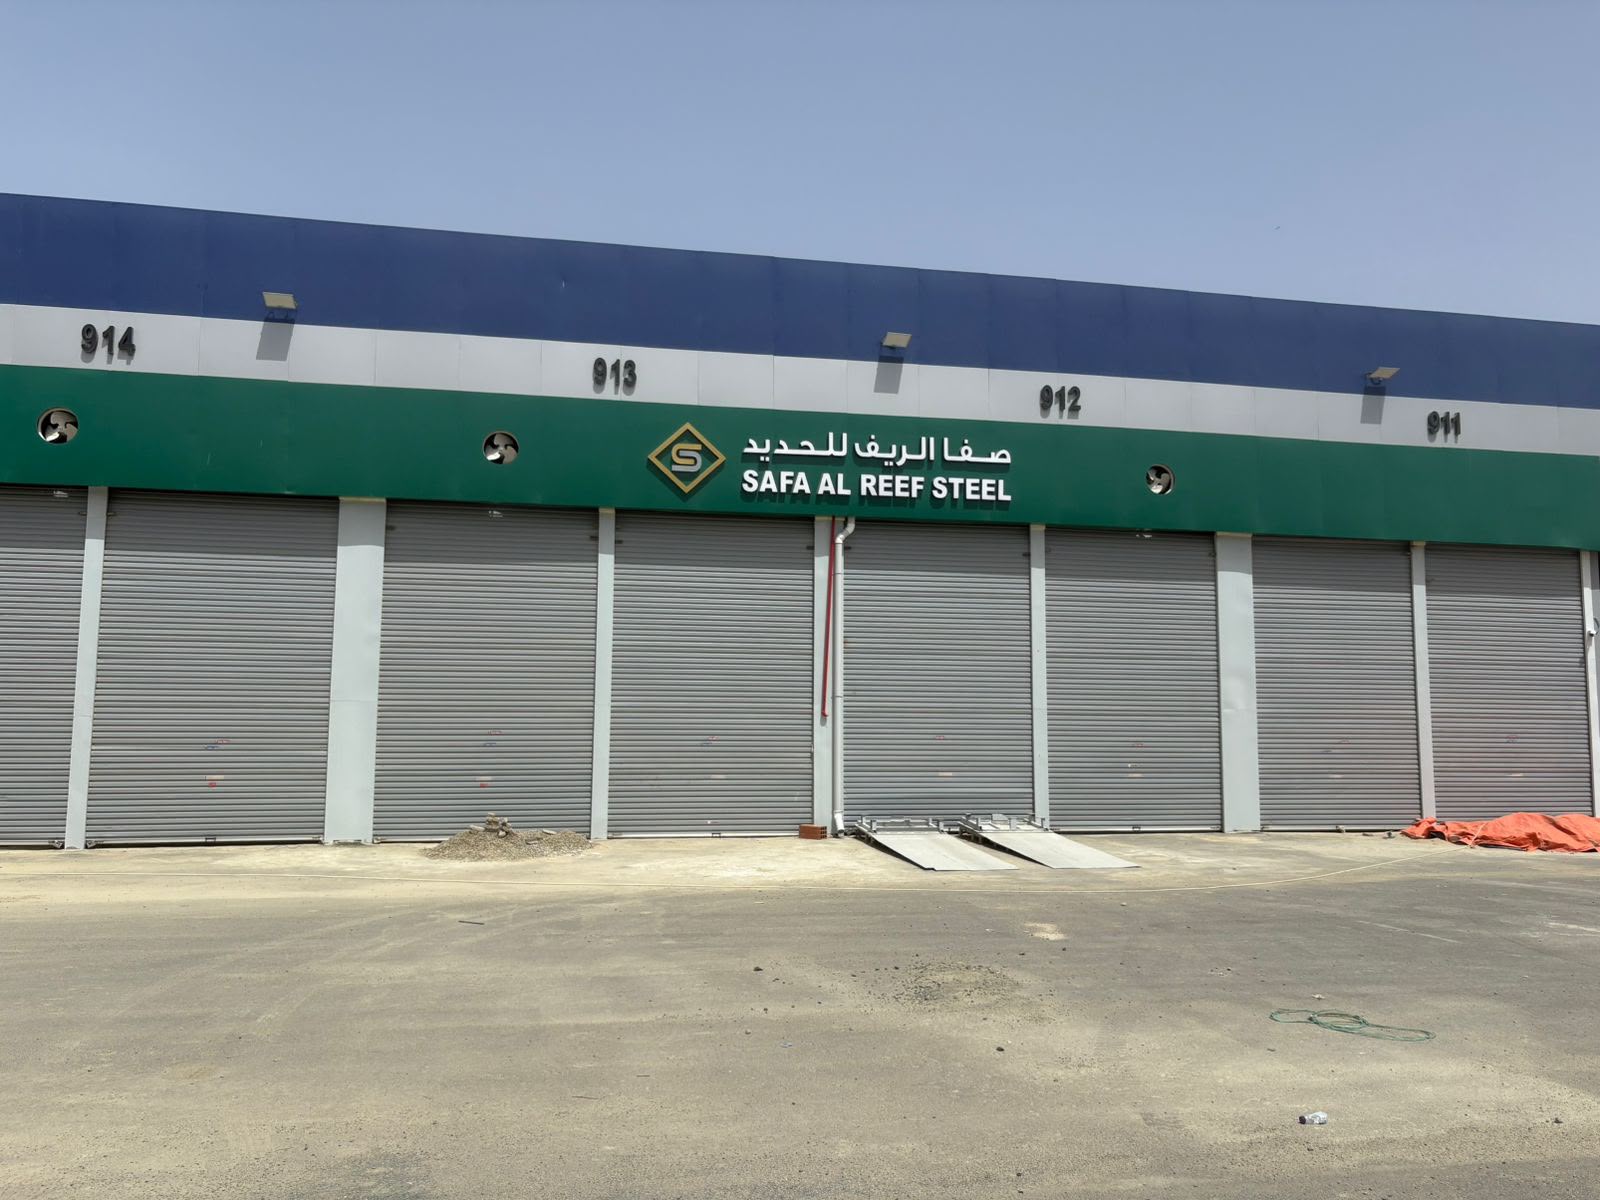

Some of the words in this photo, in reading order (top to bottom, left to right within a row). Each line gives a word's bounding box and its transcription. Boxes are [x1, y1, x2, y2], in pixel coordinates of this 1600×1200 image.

[81, 323, 136, 357] 914
[593, 357, 637, 388] 913
[1040, 384, 1082, 412] 912
[1427, 410, 1461, 436] 911
[743, 431, 848, 462] للحديد
[854, 434, 935, 466] الريف
[943, 437, 1012, 464] صفا
[742, 469, 811, 494] SAFA
[818, 472, 852, 496] AL
[860, 474, 925, 498] REEF
[932, 476, 1012, 502] STEEL
